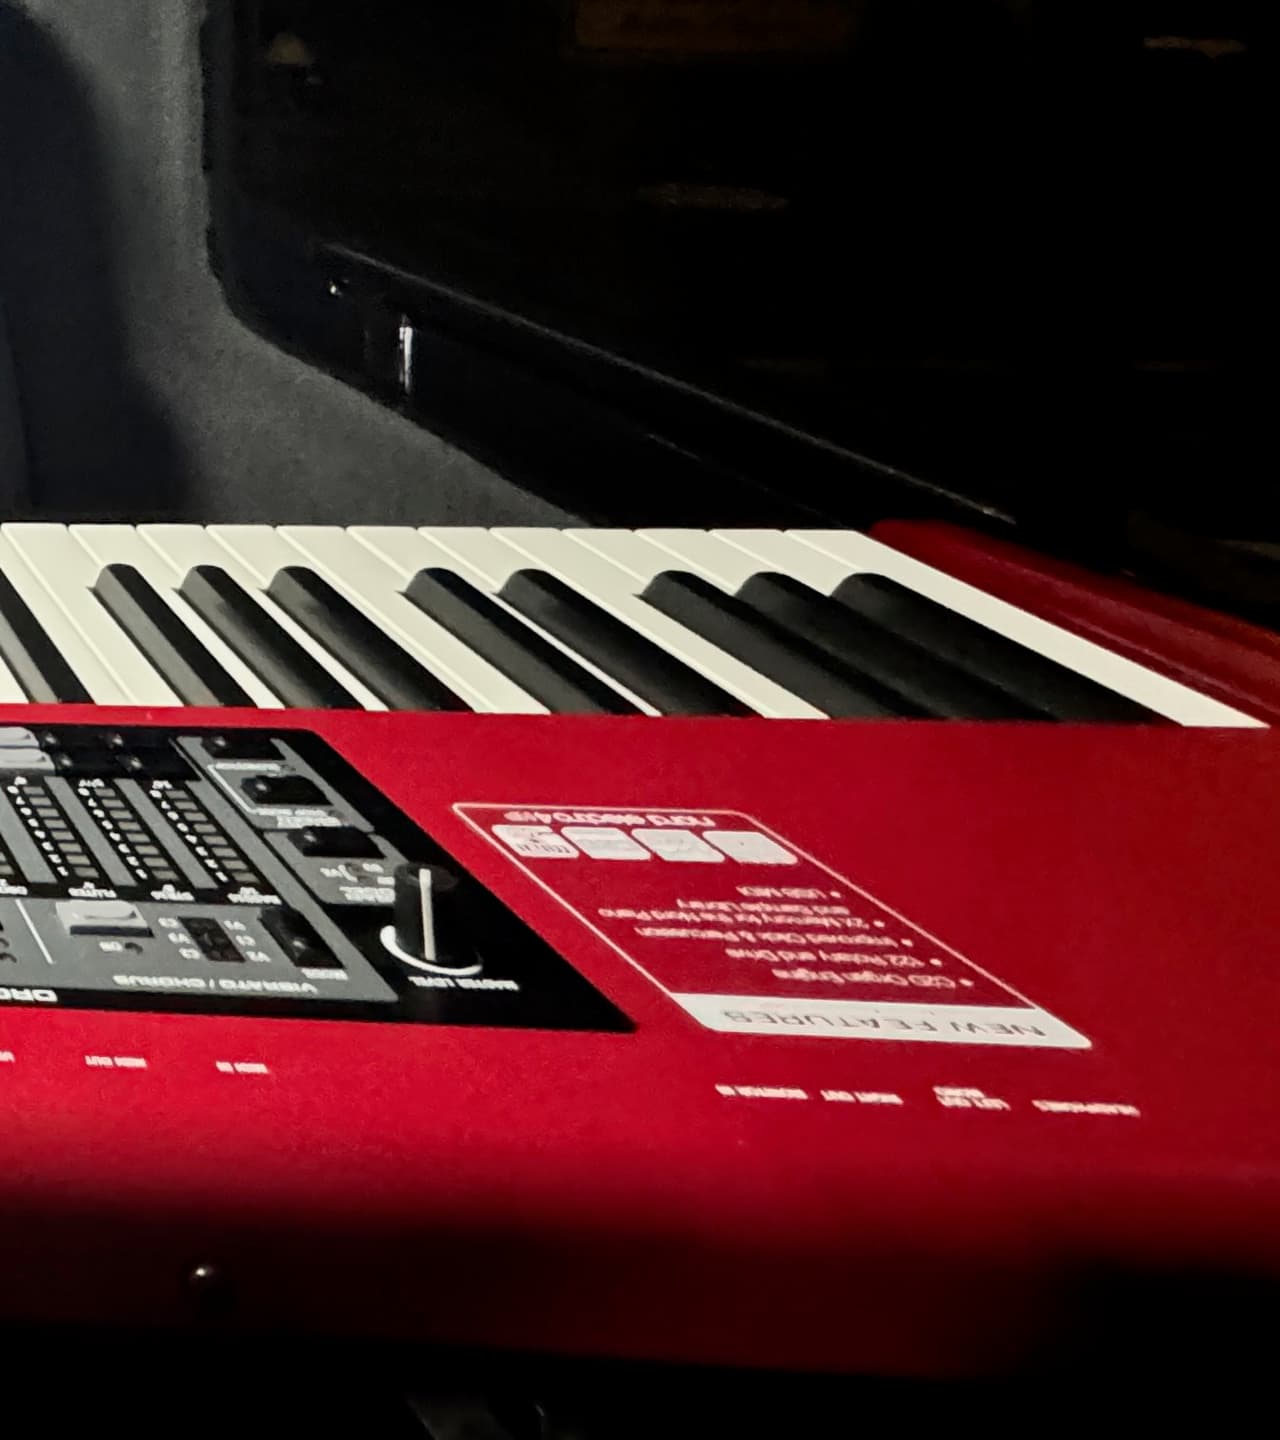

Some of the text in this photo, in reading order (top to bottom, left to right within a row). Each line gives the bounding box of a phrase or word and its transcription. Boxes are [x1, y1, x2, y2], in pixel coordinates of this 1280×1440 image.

[645, 812, 716, 827] nord
[112, 975, 318, 994] VIBRATO CHORUS
[722, 1010, 1046, 1037] NEW FEATURES
